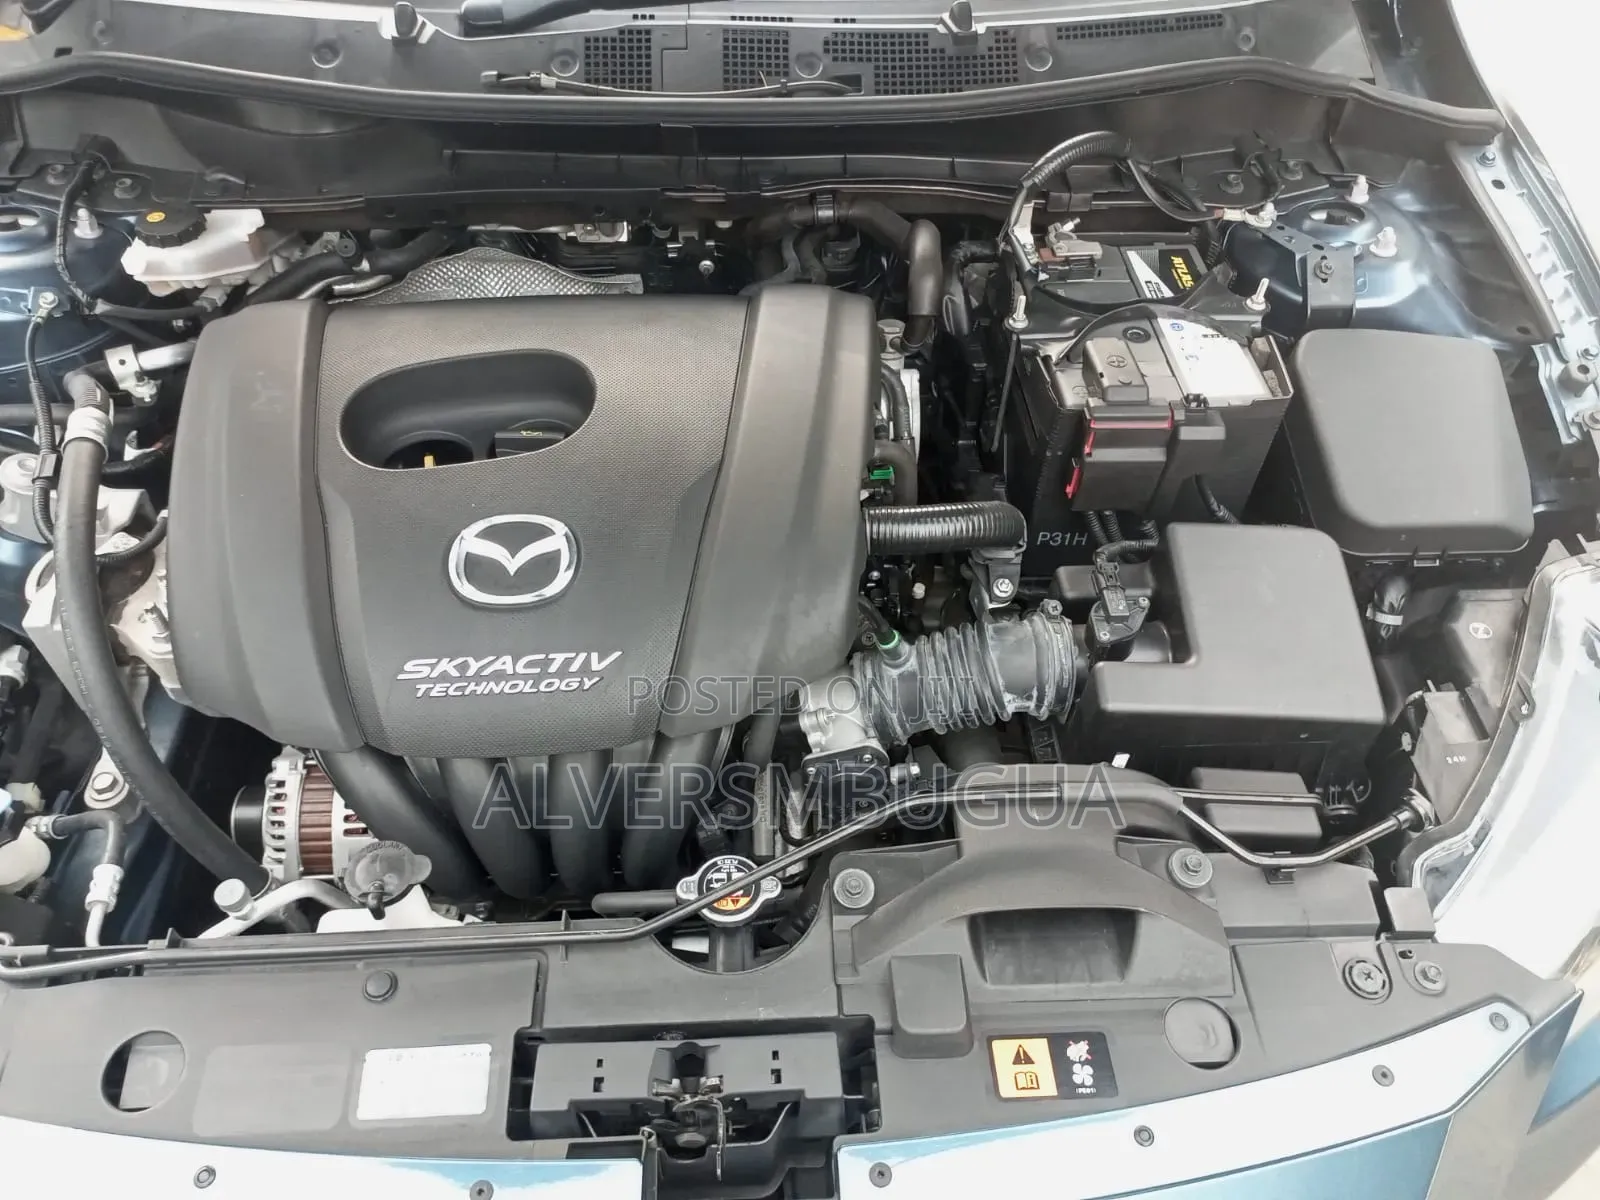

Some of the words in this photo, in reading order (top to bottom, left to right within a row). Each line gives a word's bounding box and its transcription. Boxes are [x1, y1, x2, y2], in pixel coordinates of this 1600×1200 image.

[1171, 256, 1194, 288] ATLAS
[1036, 531, 1089, 547] P31H
[397, 650, 623, 680] SKYACTIV
[415, 676, 604, 698] TECHNOLOGY
